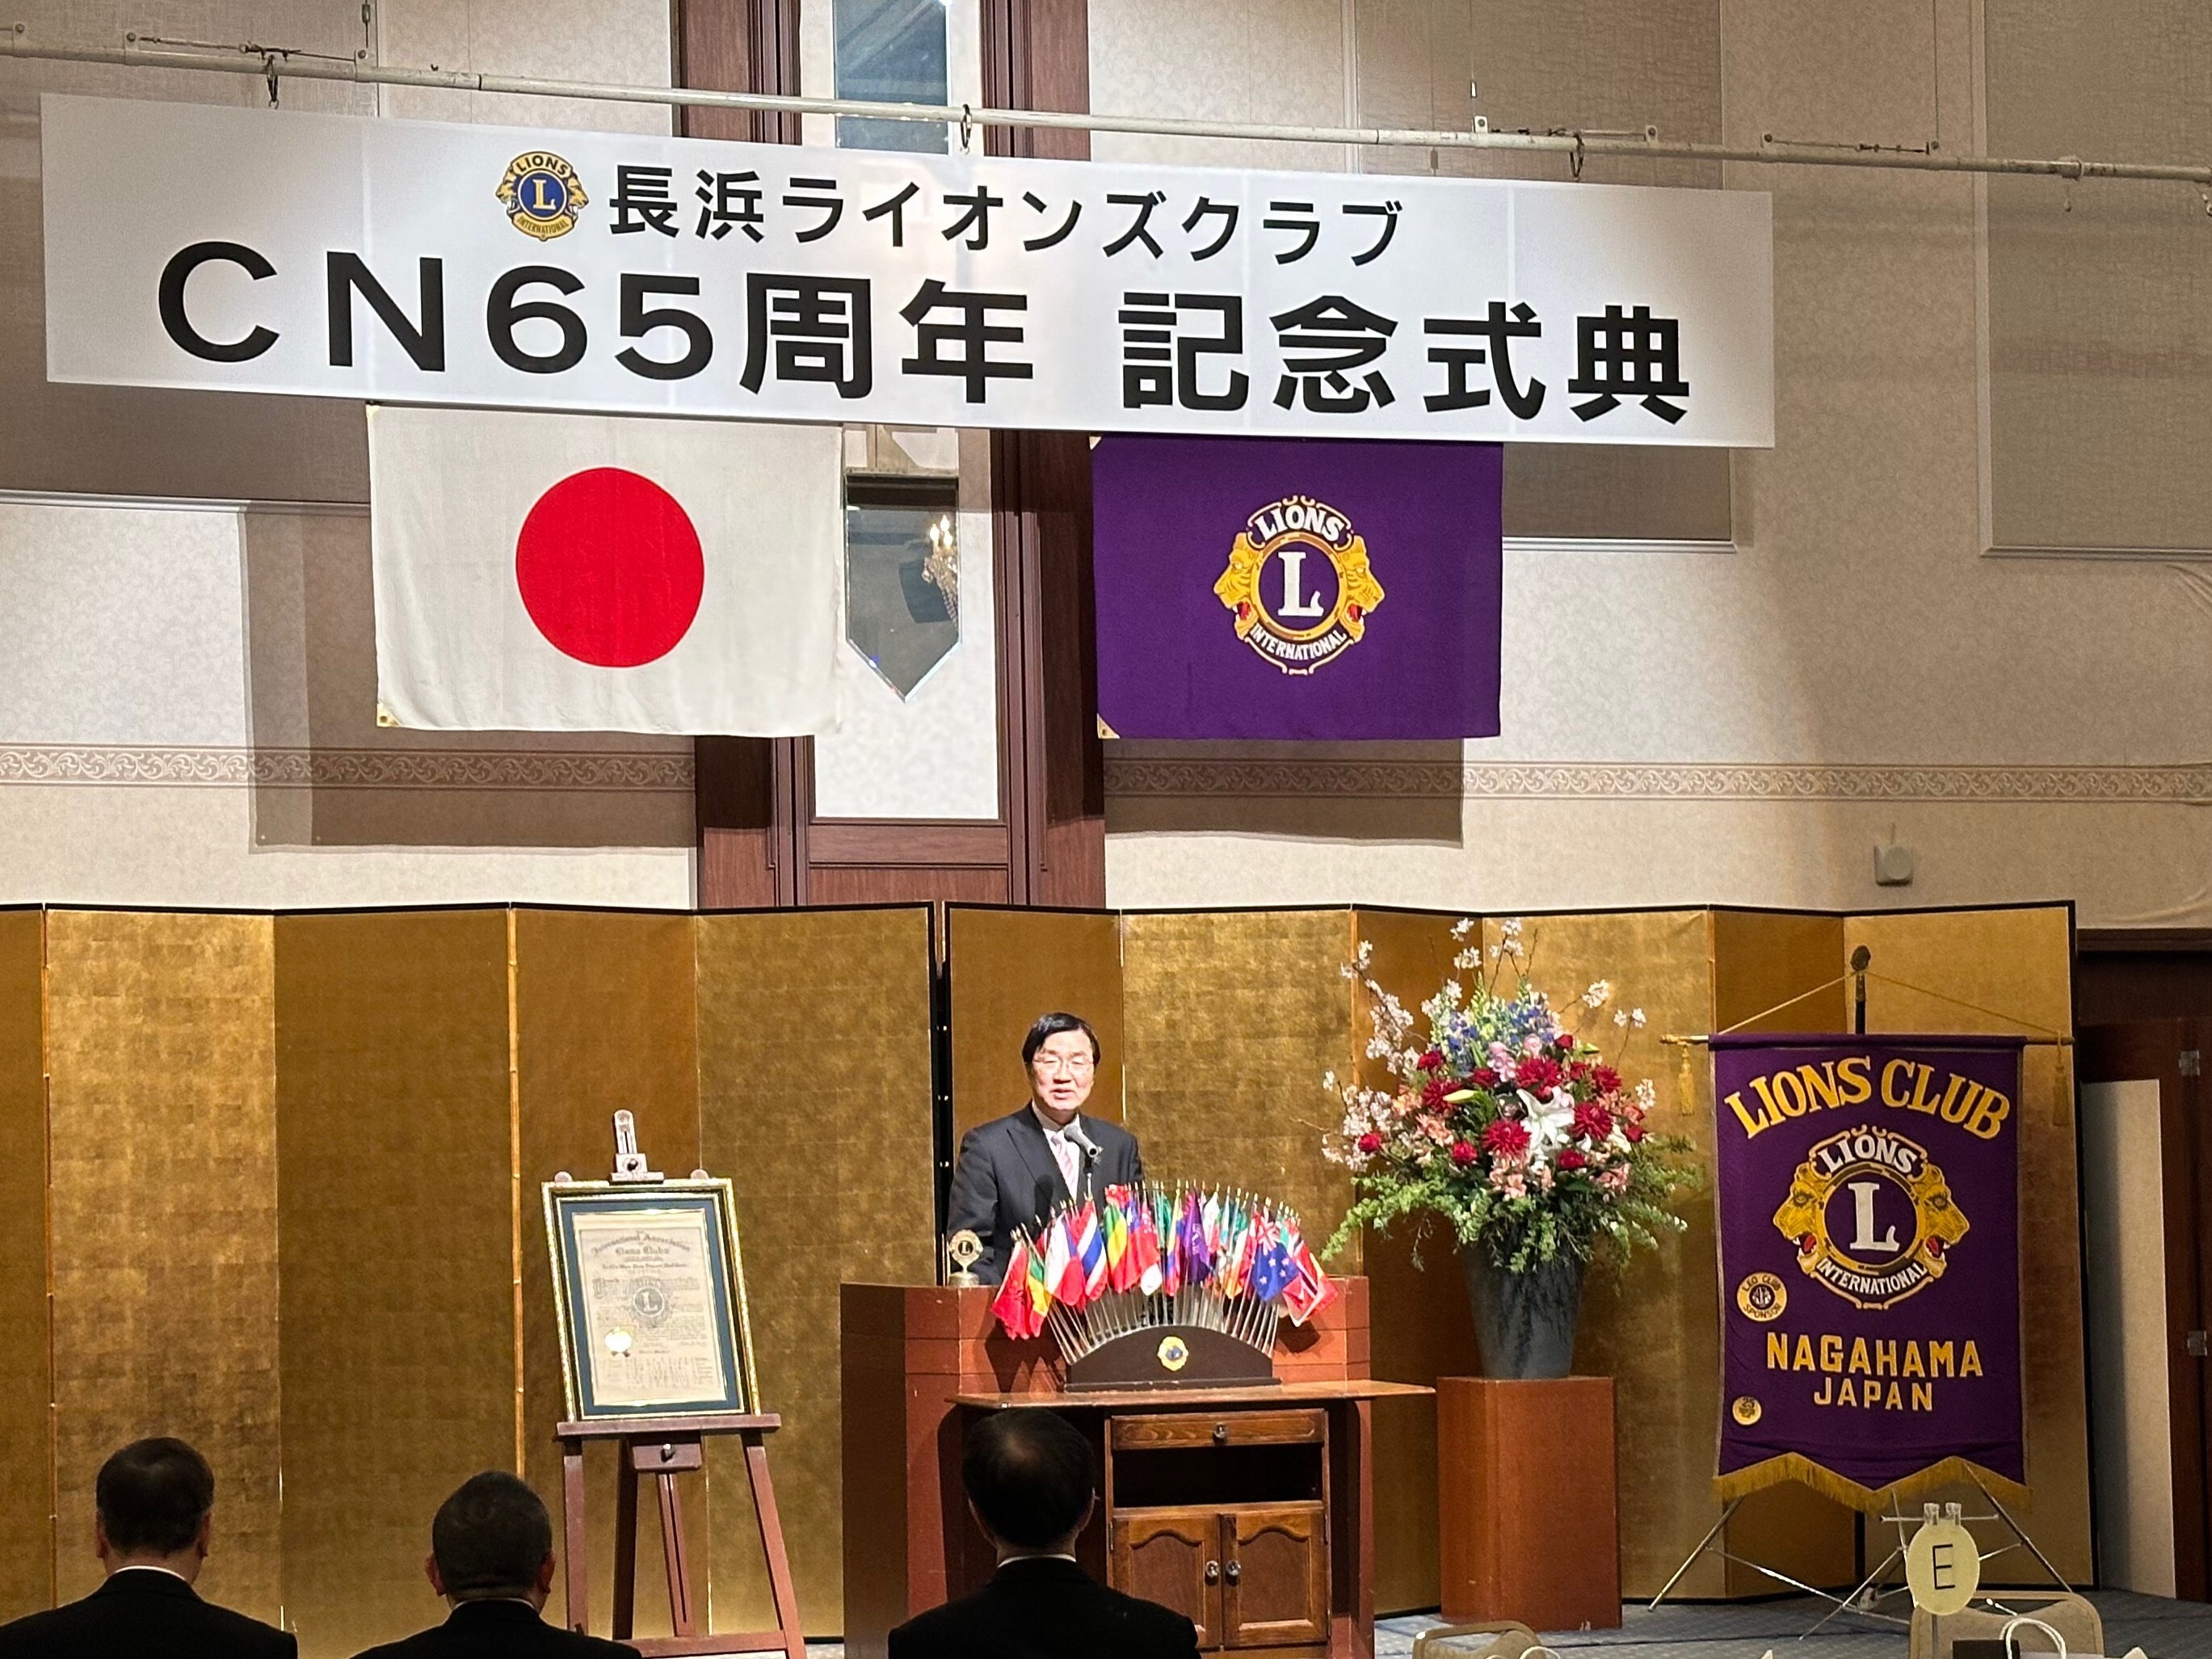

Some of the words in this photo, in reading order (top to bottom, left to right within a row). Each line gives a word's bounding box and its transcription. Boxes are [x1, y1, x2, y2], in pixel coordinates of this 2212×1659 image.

[515, 155, 568, 175] LIONS
[532, 179, 557, 210] L
[517, 215, 569, 234] INTERNATIONAL
[609, 164, 1403, 267] 長浜ライオンズクラブ
[158, 240, 1034, 404] CN65周年
[1118, 290, 1690, 425] 記念式典
[1254, 504, 1345, 542] LIONS
[1277, 551, 1324, 617] L
[1250, 622, 1348, 661] INTERNATIONAL
[1724, 1055, 1873, 1139] LIONS
[1881, 1058, 2011, 1140] CLUB
[1816, 1134, 1919, 1175] LIONS
[1847, 1182, 1899, 1252] L
[1741, 1275, 1759, 1292] LEO
[1816, 1259, 1926, 1296] INTERNATIONAL
[1766, 1331, 1983, 1378] NAGAHAMA
[1814, 1376, 1933, 1412] JAPAN
[1932, 1543, 1956, 1590] E
